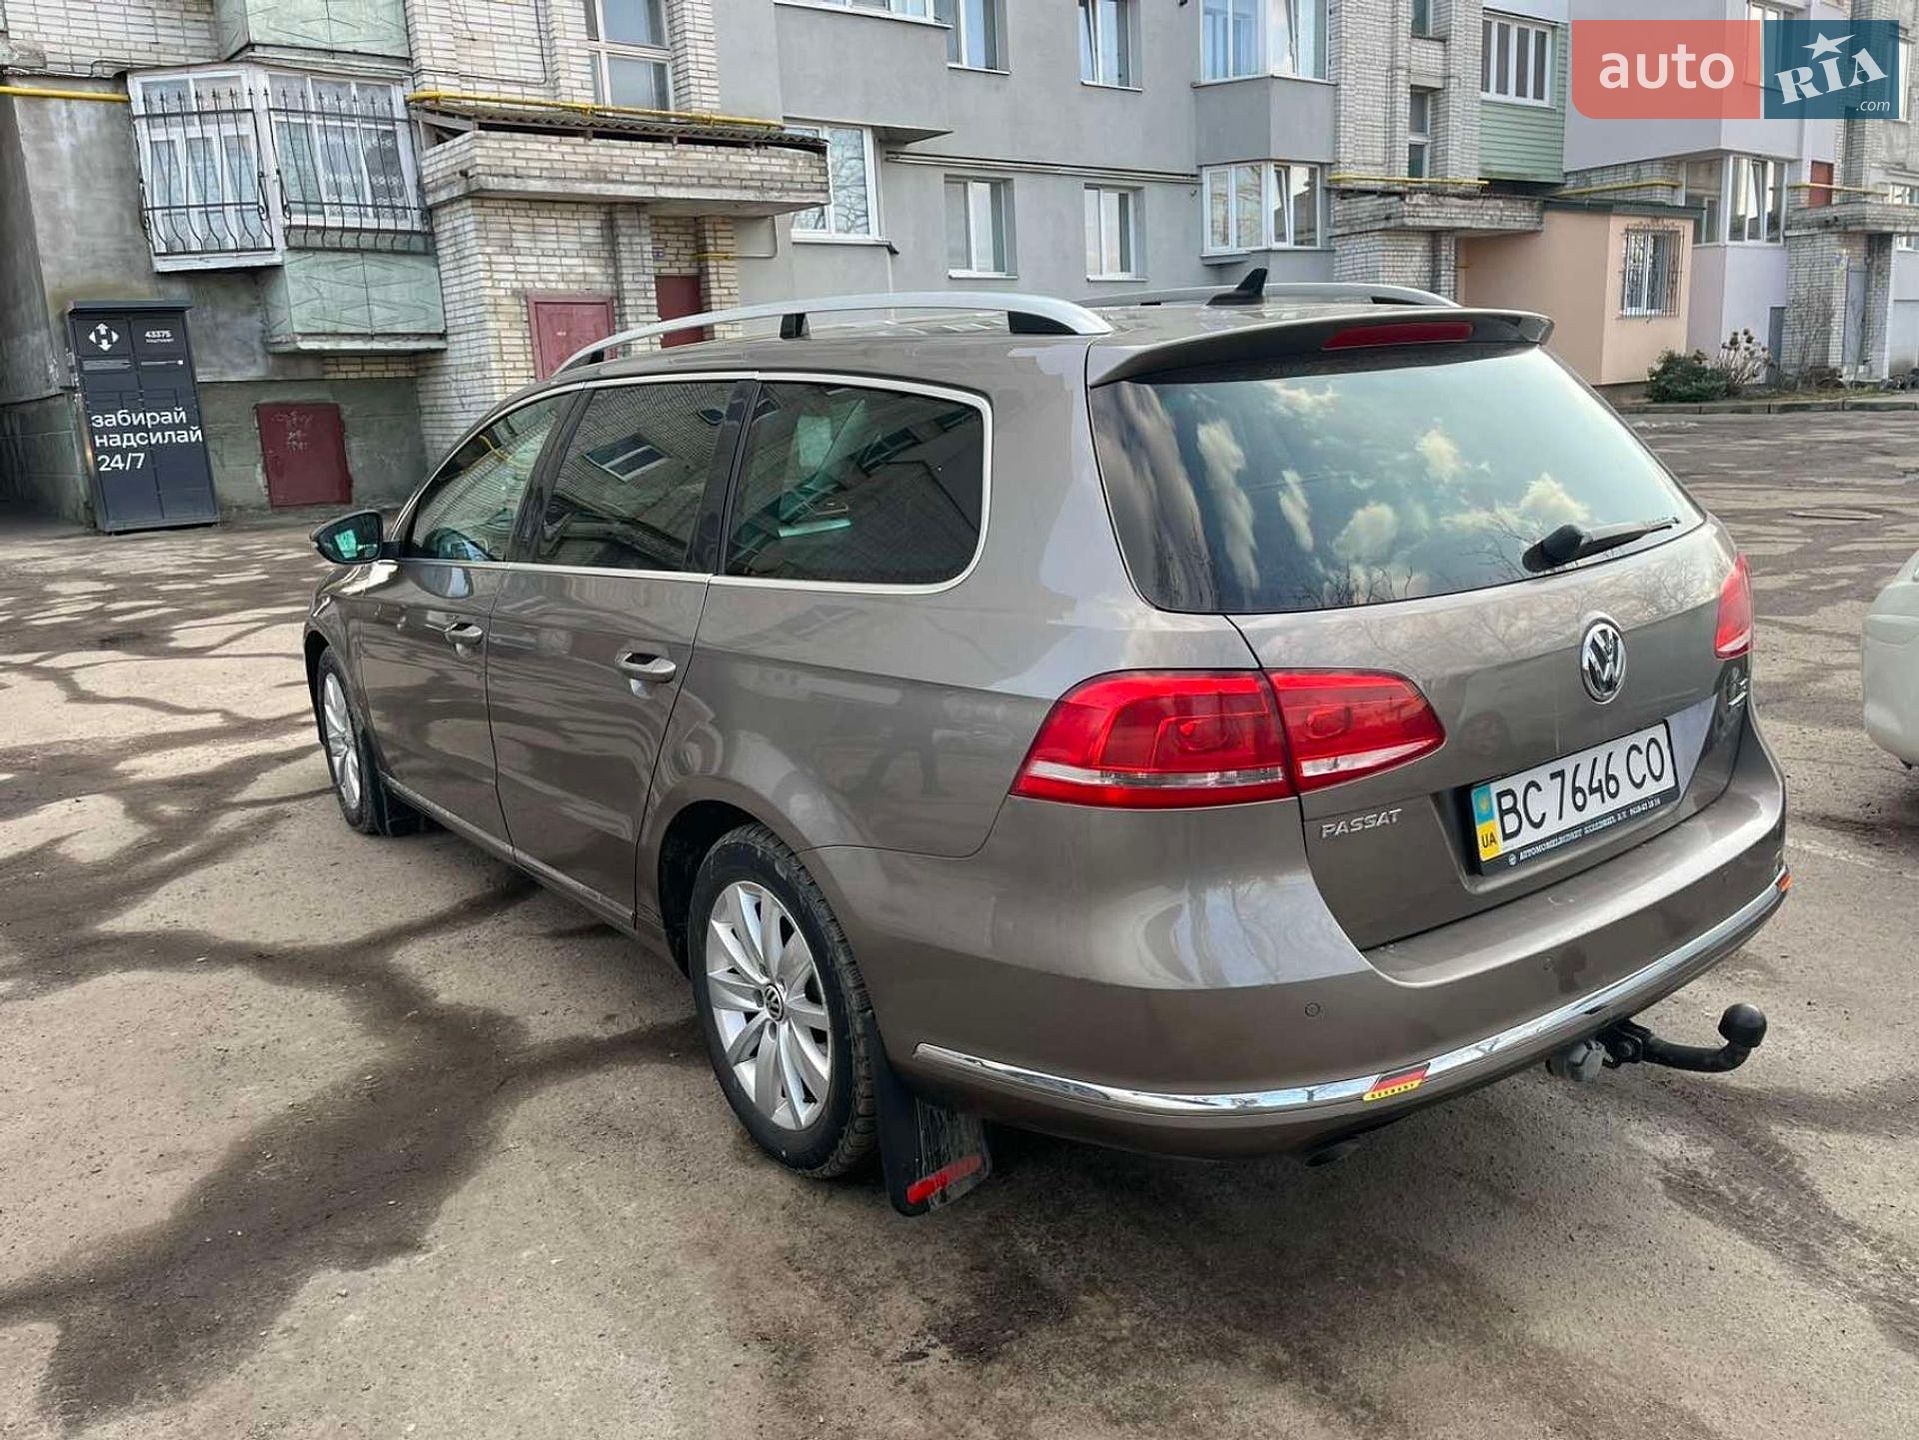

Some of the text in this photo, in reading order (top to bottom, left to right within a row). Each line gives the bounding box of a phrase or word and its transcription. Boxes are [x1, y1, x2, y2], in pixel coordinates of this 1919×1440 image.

[91, 407, 187, 429] забирай
[94, 426, 203, 449] надсилай
[97, 452, 146, 472] 24/7
[1496, 737, 1665, 842] BC 7646 CO
[1321, 807, 1403, 839] PASSAT
[1481, 834, 1497, 849] UA
